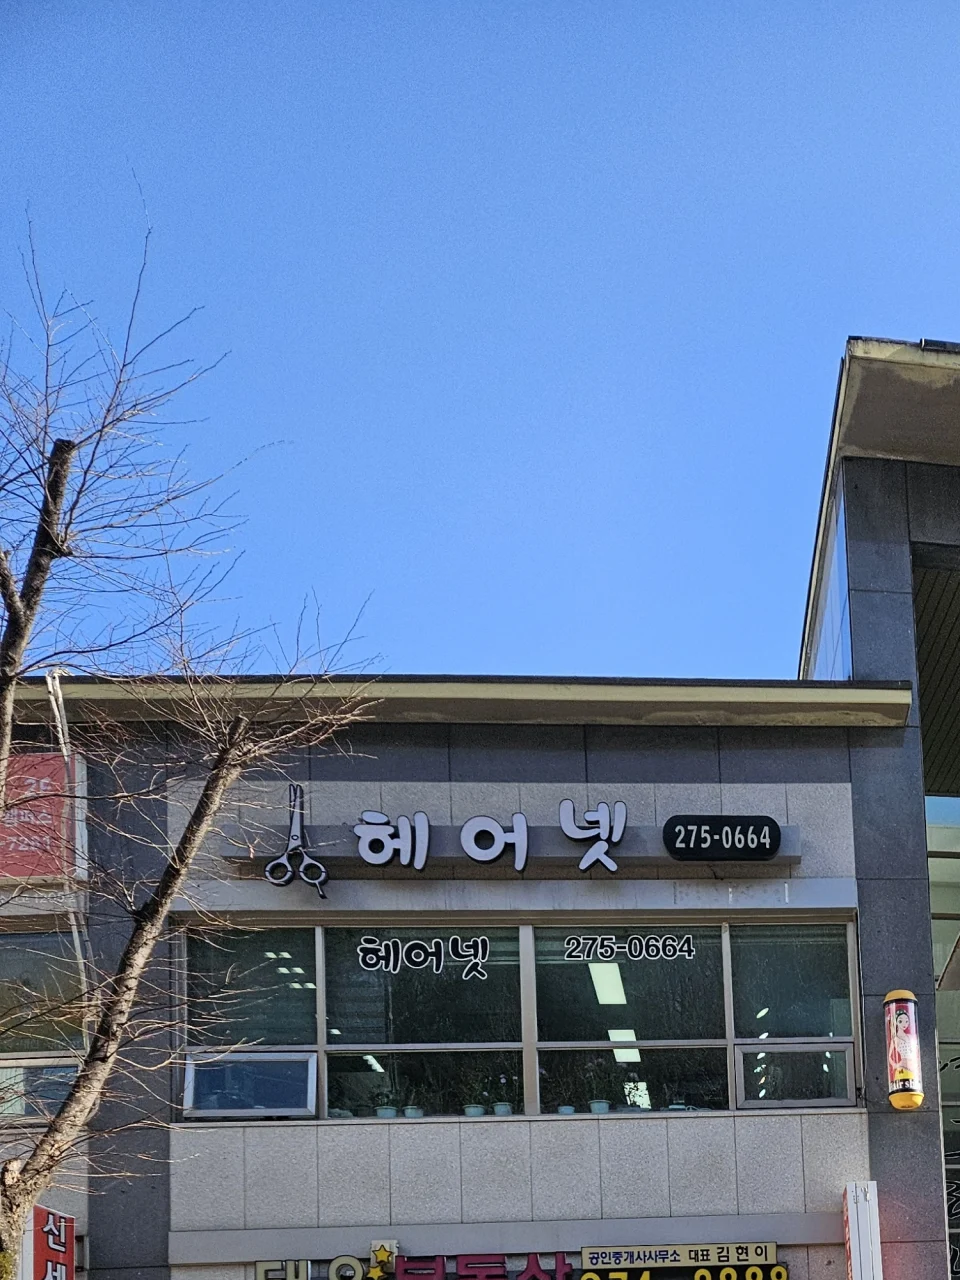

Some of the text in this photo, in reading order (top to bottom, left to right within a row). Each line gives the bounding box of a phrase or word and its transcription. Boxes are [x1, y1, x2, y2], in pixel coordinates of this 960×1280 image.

[353, 798, 771, 874] 헤어넷 275-0664
[357, 936, 490, 980] 헤어넷
[563, 935, 696, 961] 275-0664
[588, 1250, 681, 1266] 공인중개사사무소
[688, 1247, 711, 1263] 대표
